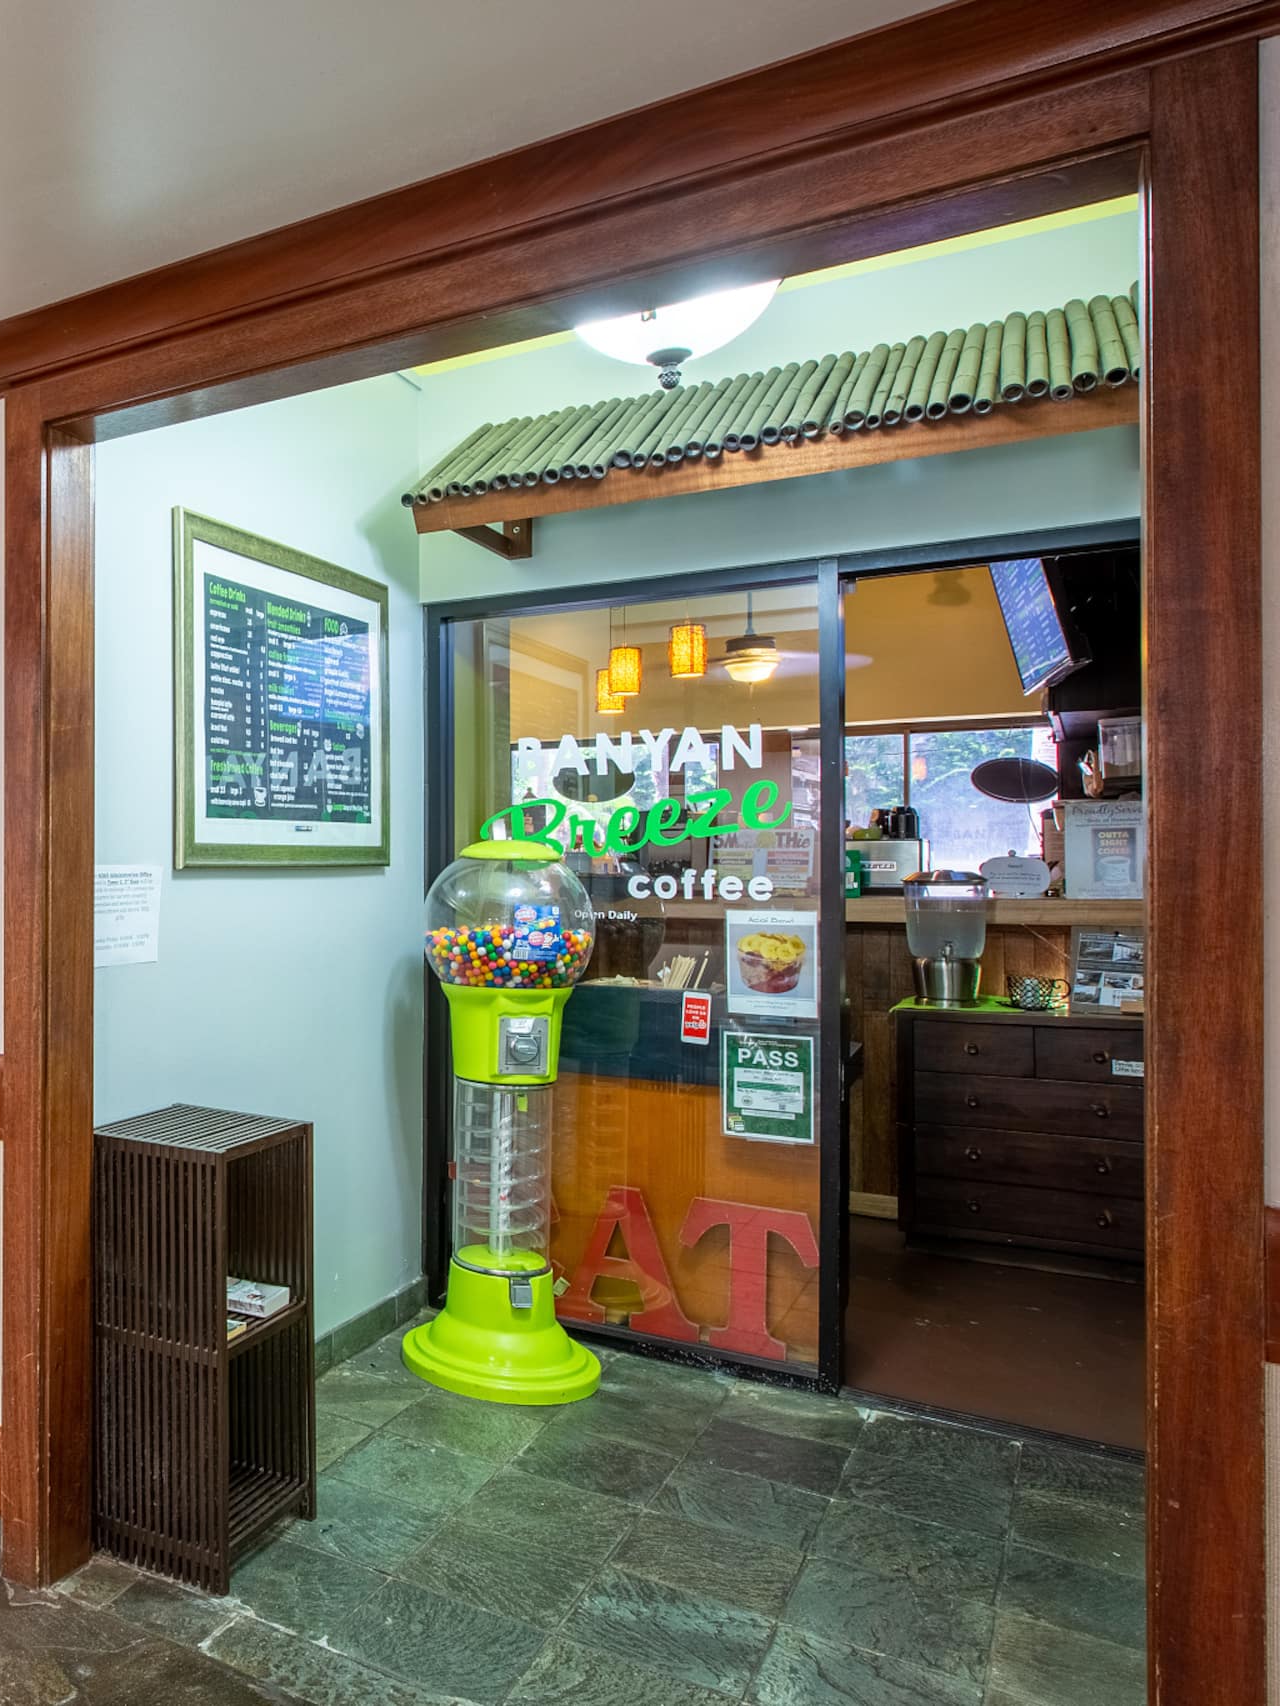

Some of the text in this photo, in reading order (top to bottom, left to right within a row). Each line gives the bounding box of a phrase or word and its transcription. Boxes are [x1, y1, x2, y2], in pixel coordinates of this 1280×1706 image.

[209, 581, 227, 598] Coffee
[324, 617, 338, 634] FOOD
[517, 724, 762, 776] BANYAN
[480, 779, 792, 861] Breeze
[628, 869, 773, 900] coffee
[608, 909, 638, 921] Daily
[737, 1047, 799, 1068] PASS
